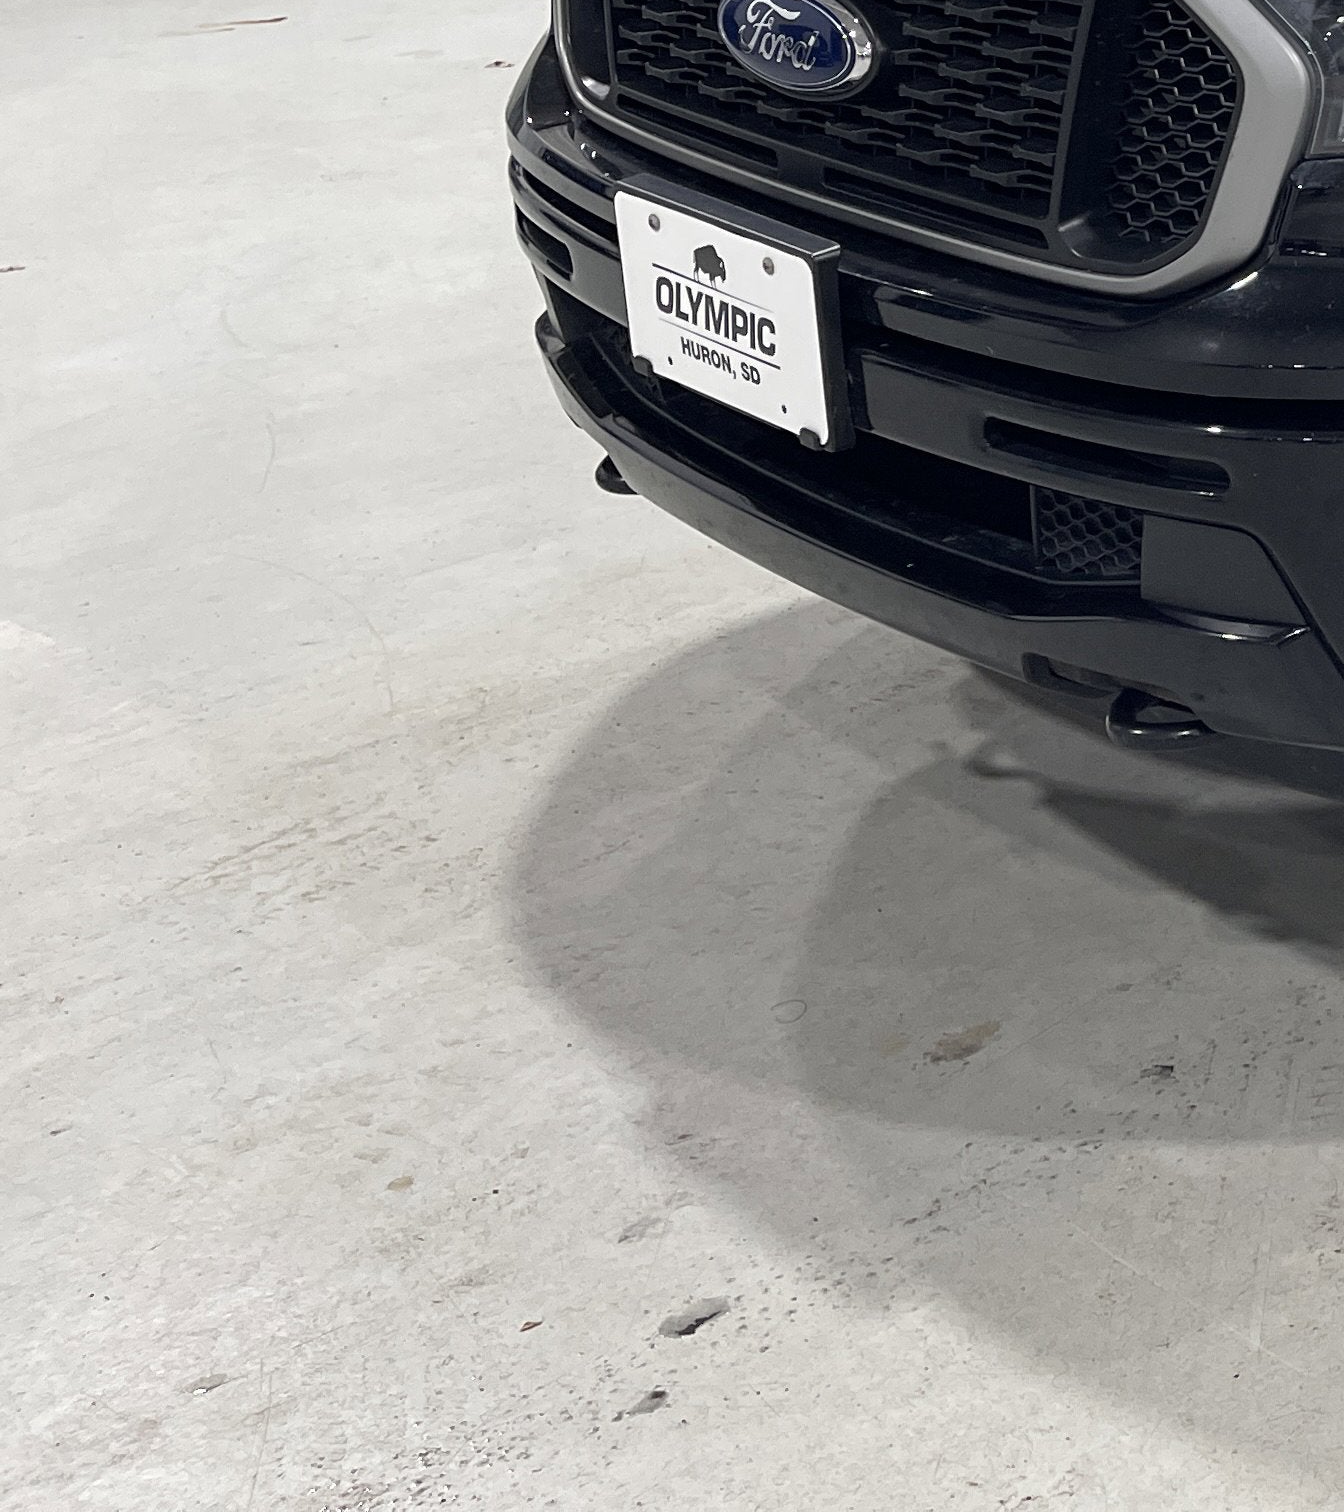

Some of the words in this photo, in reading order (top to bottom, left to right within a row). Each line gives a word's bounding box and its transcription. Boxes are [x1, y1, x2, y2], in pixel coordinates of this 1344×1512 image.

[656, 276, 776, 356] OLYMPIC
[680, 337, 736, 379] HURON,
[740, 361, 760, 384] SD
